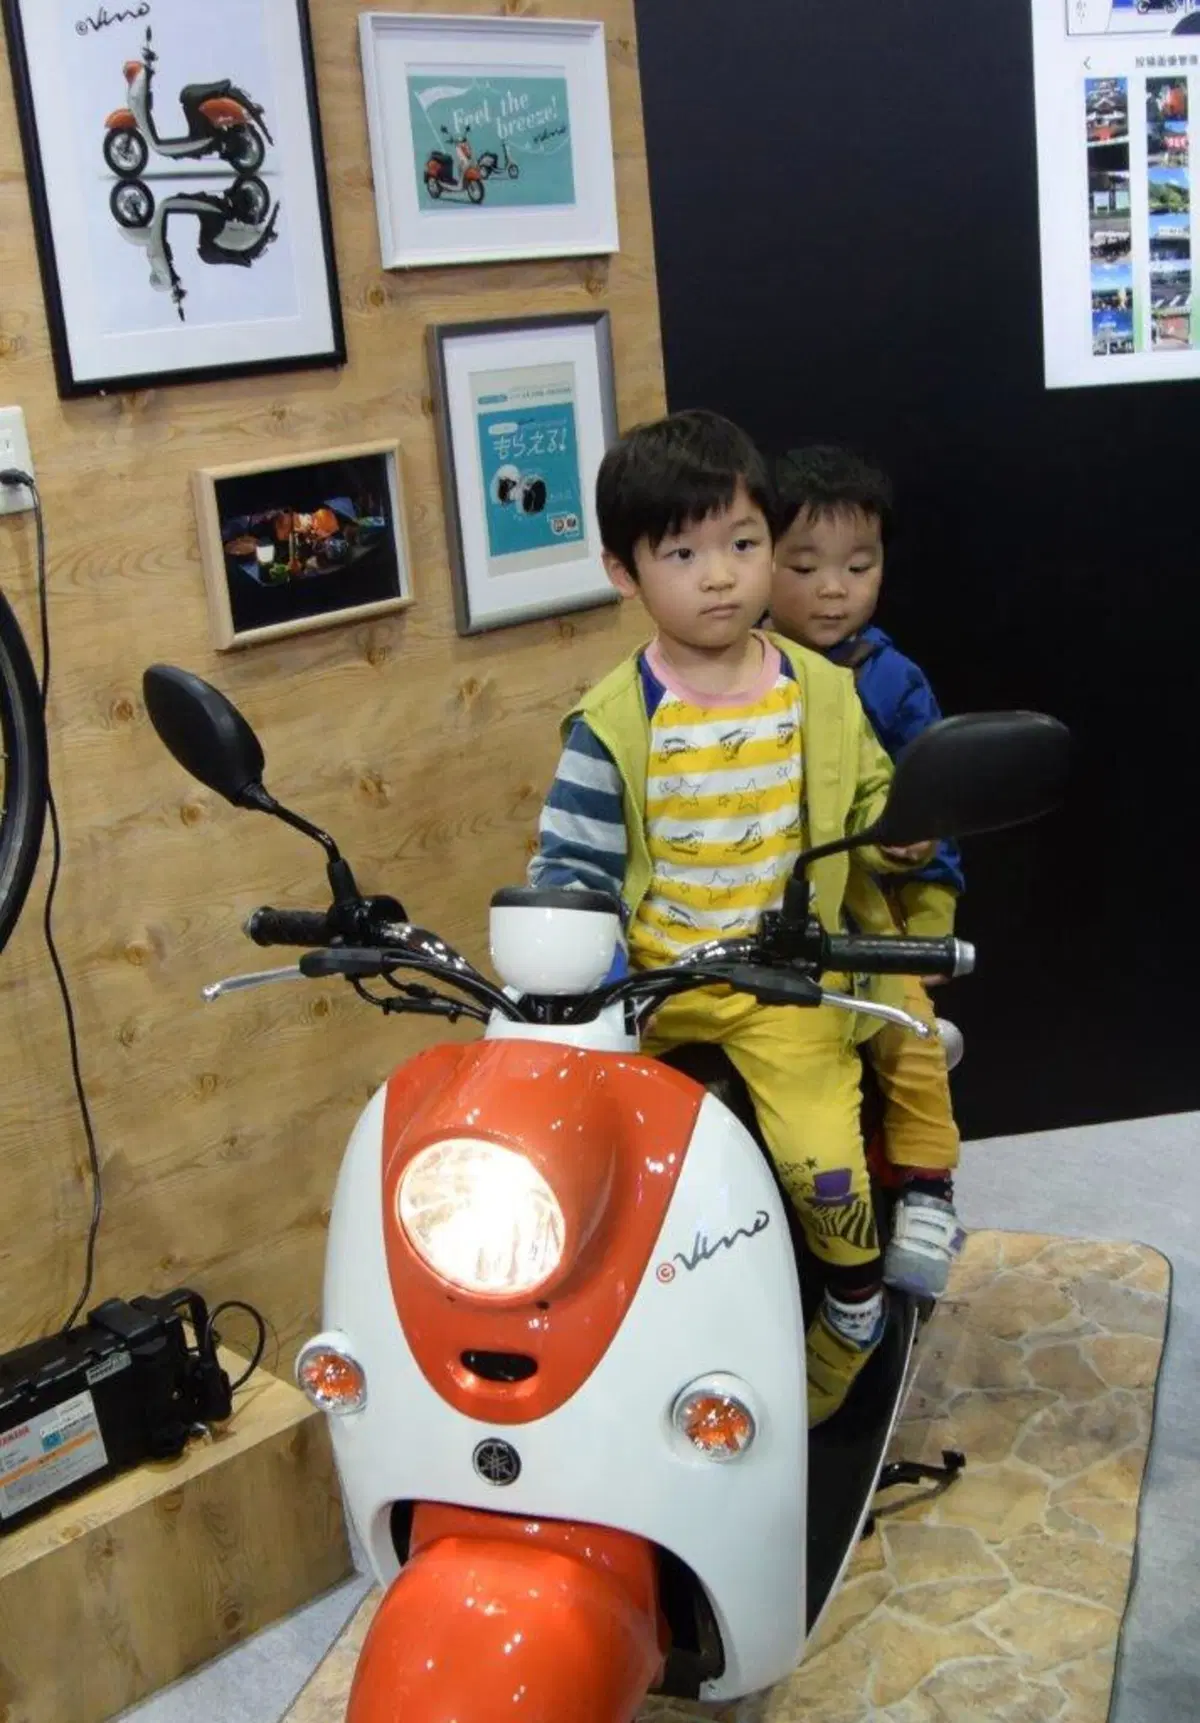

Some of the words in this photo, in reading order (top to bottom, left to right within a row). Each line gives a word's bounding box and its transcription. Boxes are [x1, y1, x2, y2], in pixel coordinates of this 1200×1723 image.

[453, 98, 490, 133] Feel
[500, 90, 529, 117] the
[496, 95, 558, 140] breeze!
